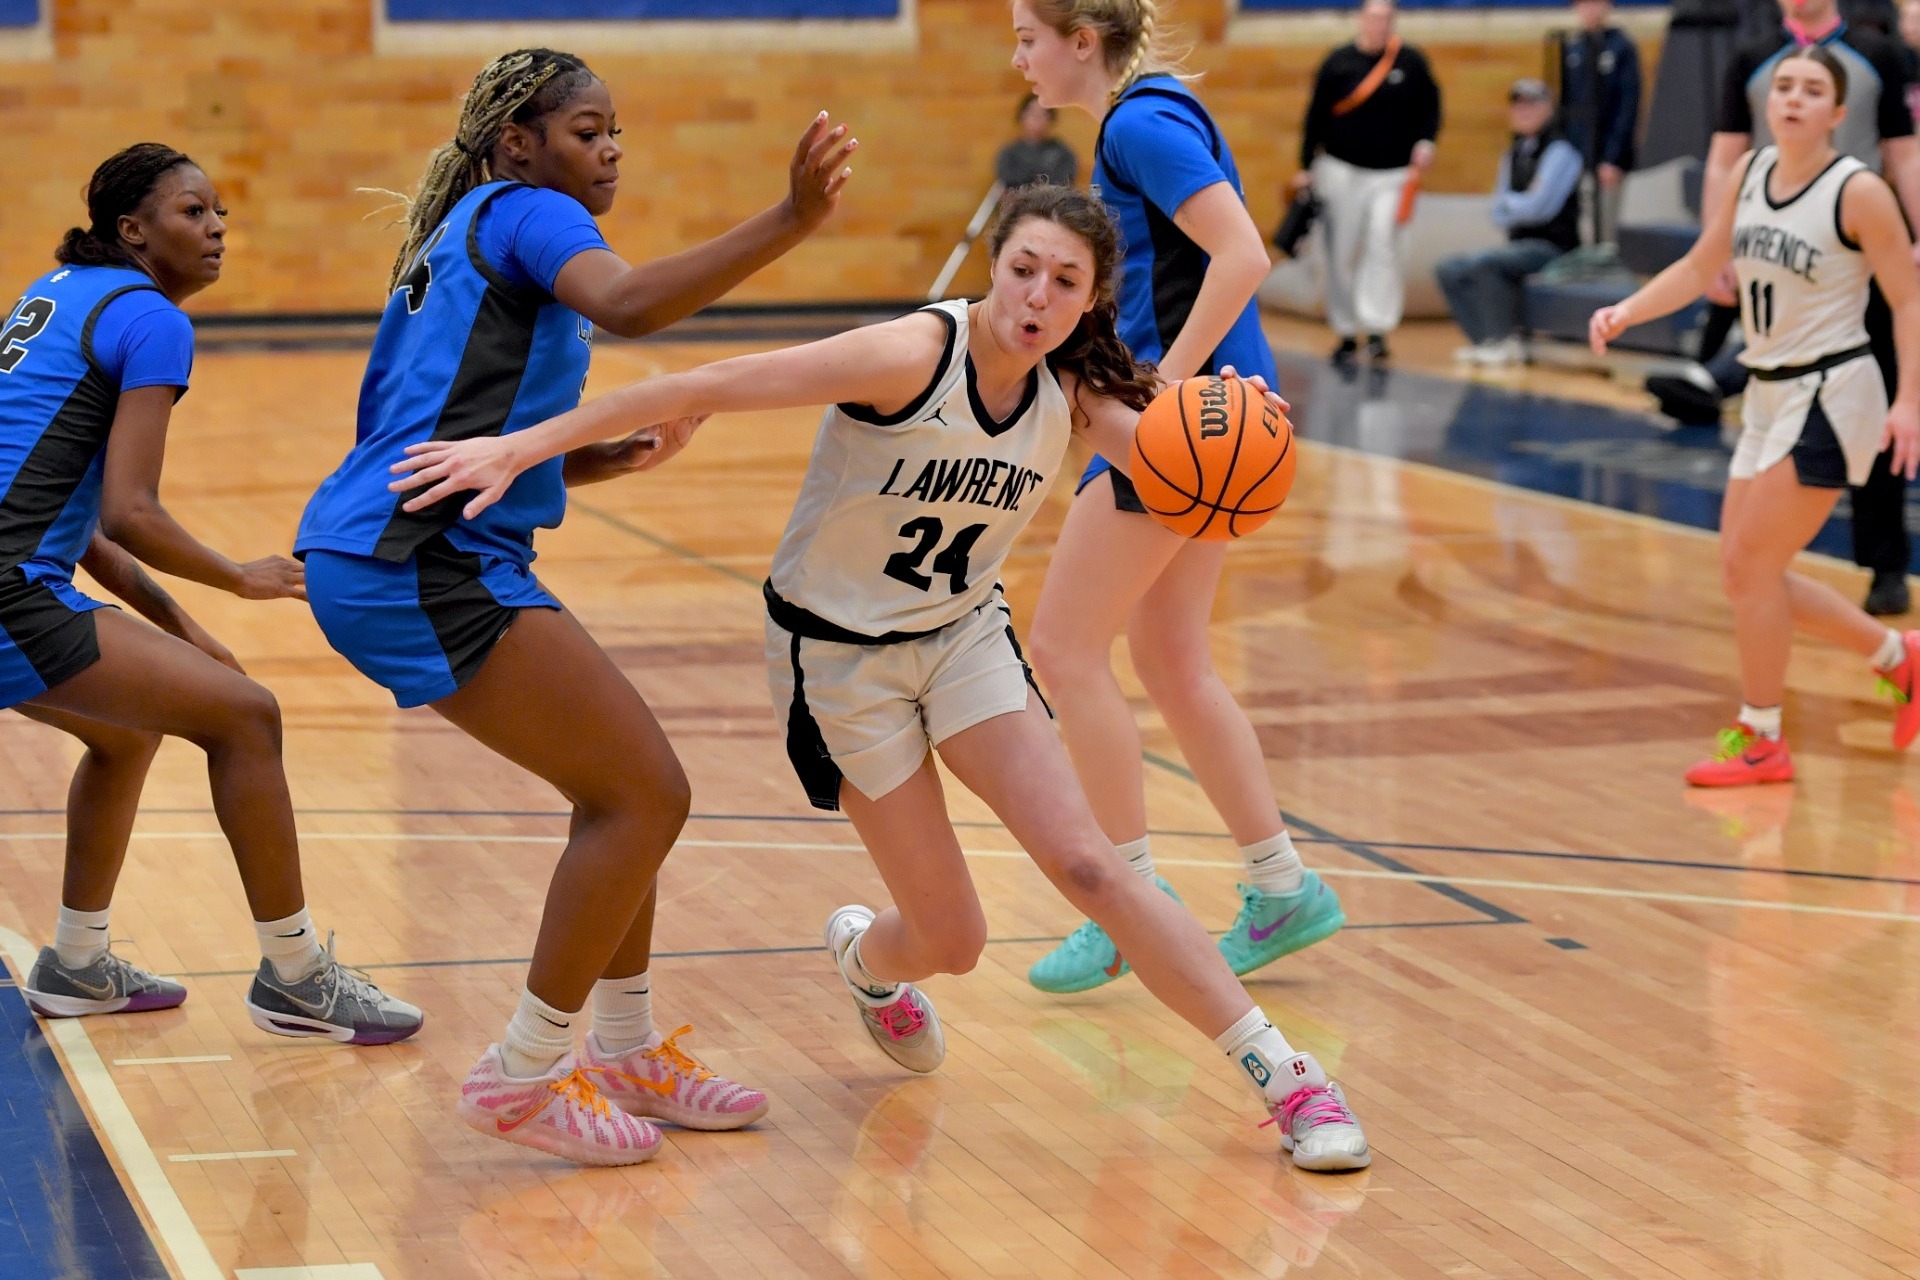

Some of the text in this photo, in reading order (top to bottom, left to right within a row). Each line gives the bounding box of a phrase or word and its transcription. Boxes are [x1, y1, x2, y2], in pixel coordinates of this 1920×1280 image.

[1734, 224, 1822, 284] WRENCE
[0, 295, 56, 374] 2
[1750, 279, 1774, 337] 11
[1262, 395, 1280, 439] EV
[882, 516, 990, 595] 24
